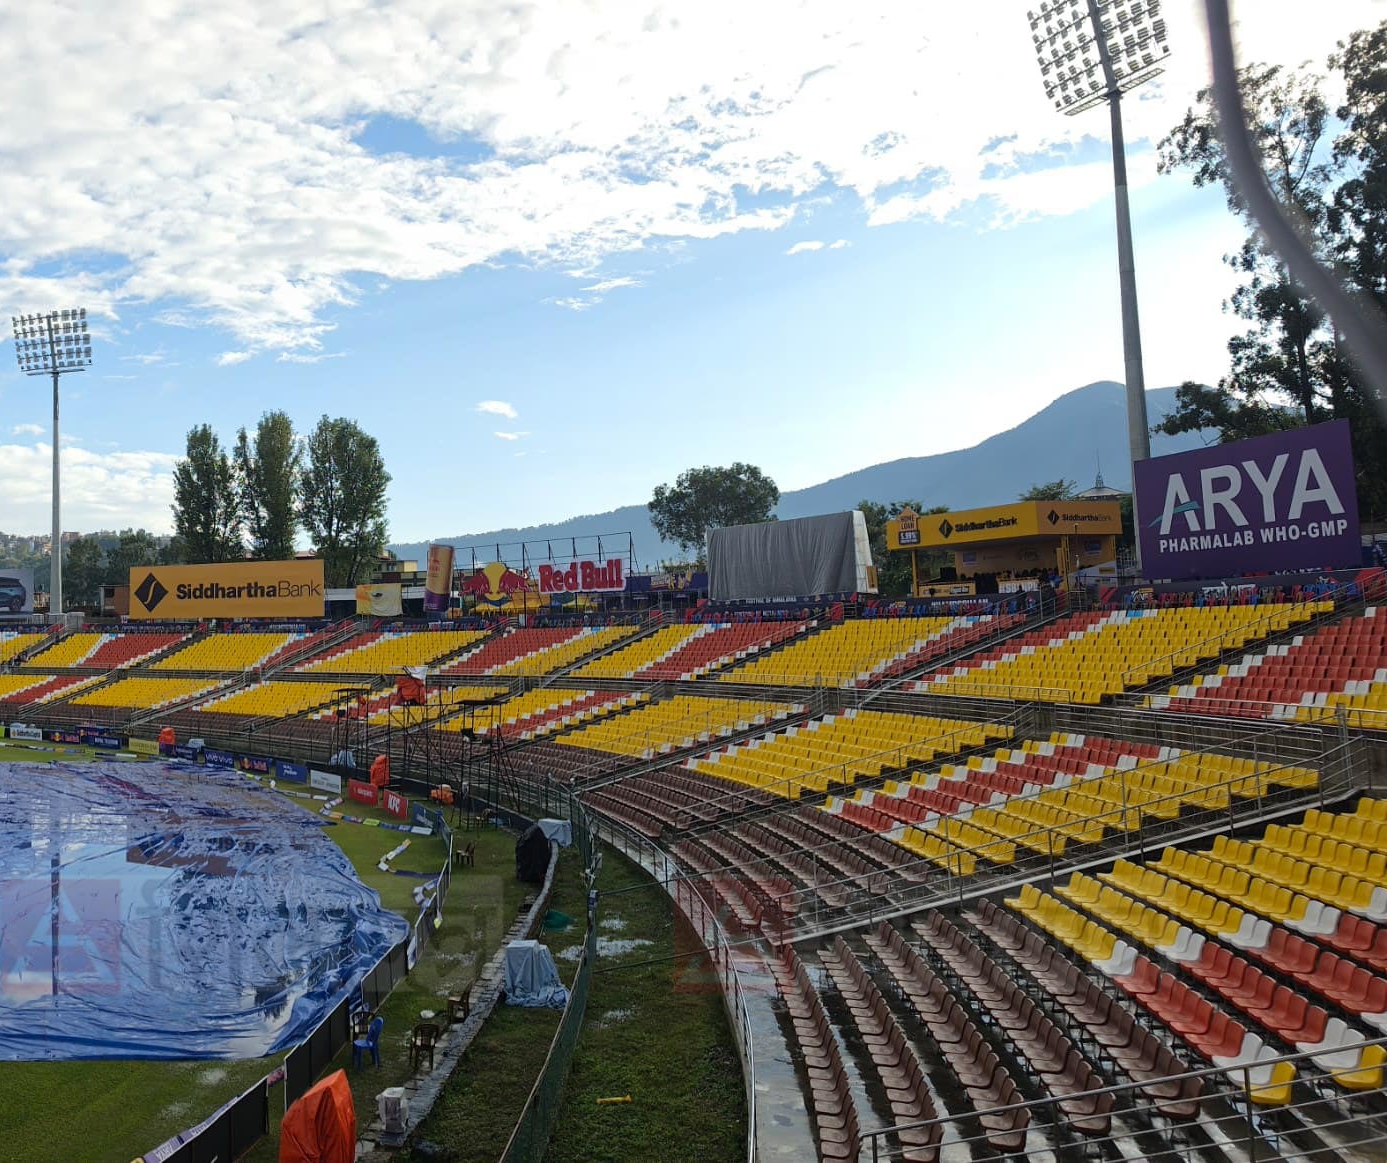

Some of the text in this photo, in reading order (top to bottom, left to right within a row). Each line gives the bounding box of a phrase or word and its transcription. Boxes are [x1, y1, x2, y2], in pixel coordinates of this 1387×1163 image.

[1159, 448, 1345, 535] ARYA
[1160, 519, 1348, 553] PHARMALAB WHO-GMP
[538, 562, 579, 594] Red
[579, 558, 624, 590] Bull
